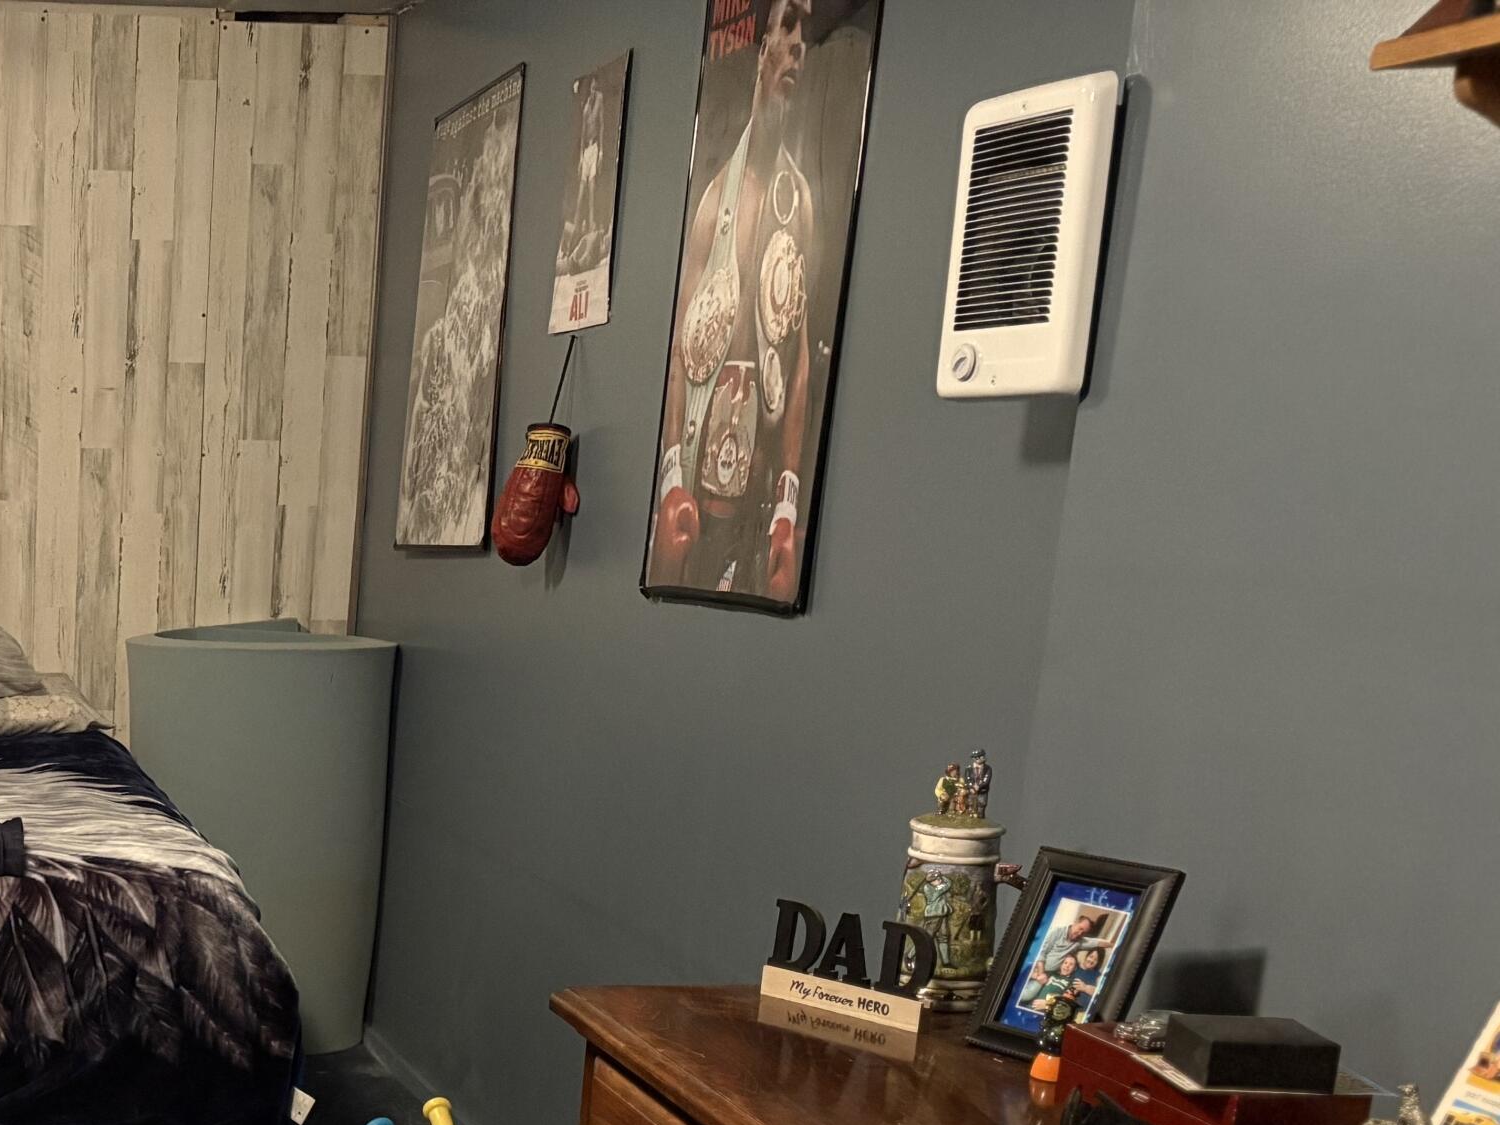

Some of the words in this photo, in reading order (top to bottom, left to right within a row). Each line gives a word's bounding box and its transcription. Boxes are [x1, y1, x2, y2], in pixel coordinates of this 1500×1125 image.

[710, 16, 756, 63] TYSON
[569, 291, 589, 321] ALI
[767, 898, 937, 999] DAD
[789, 979, 811, 1000] My
[812, 986, 854, 1008] Forever
[857, 996, 890, 1016] HERO
